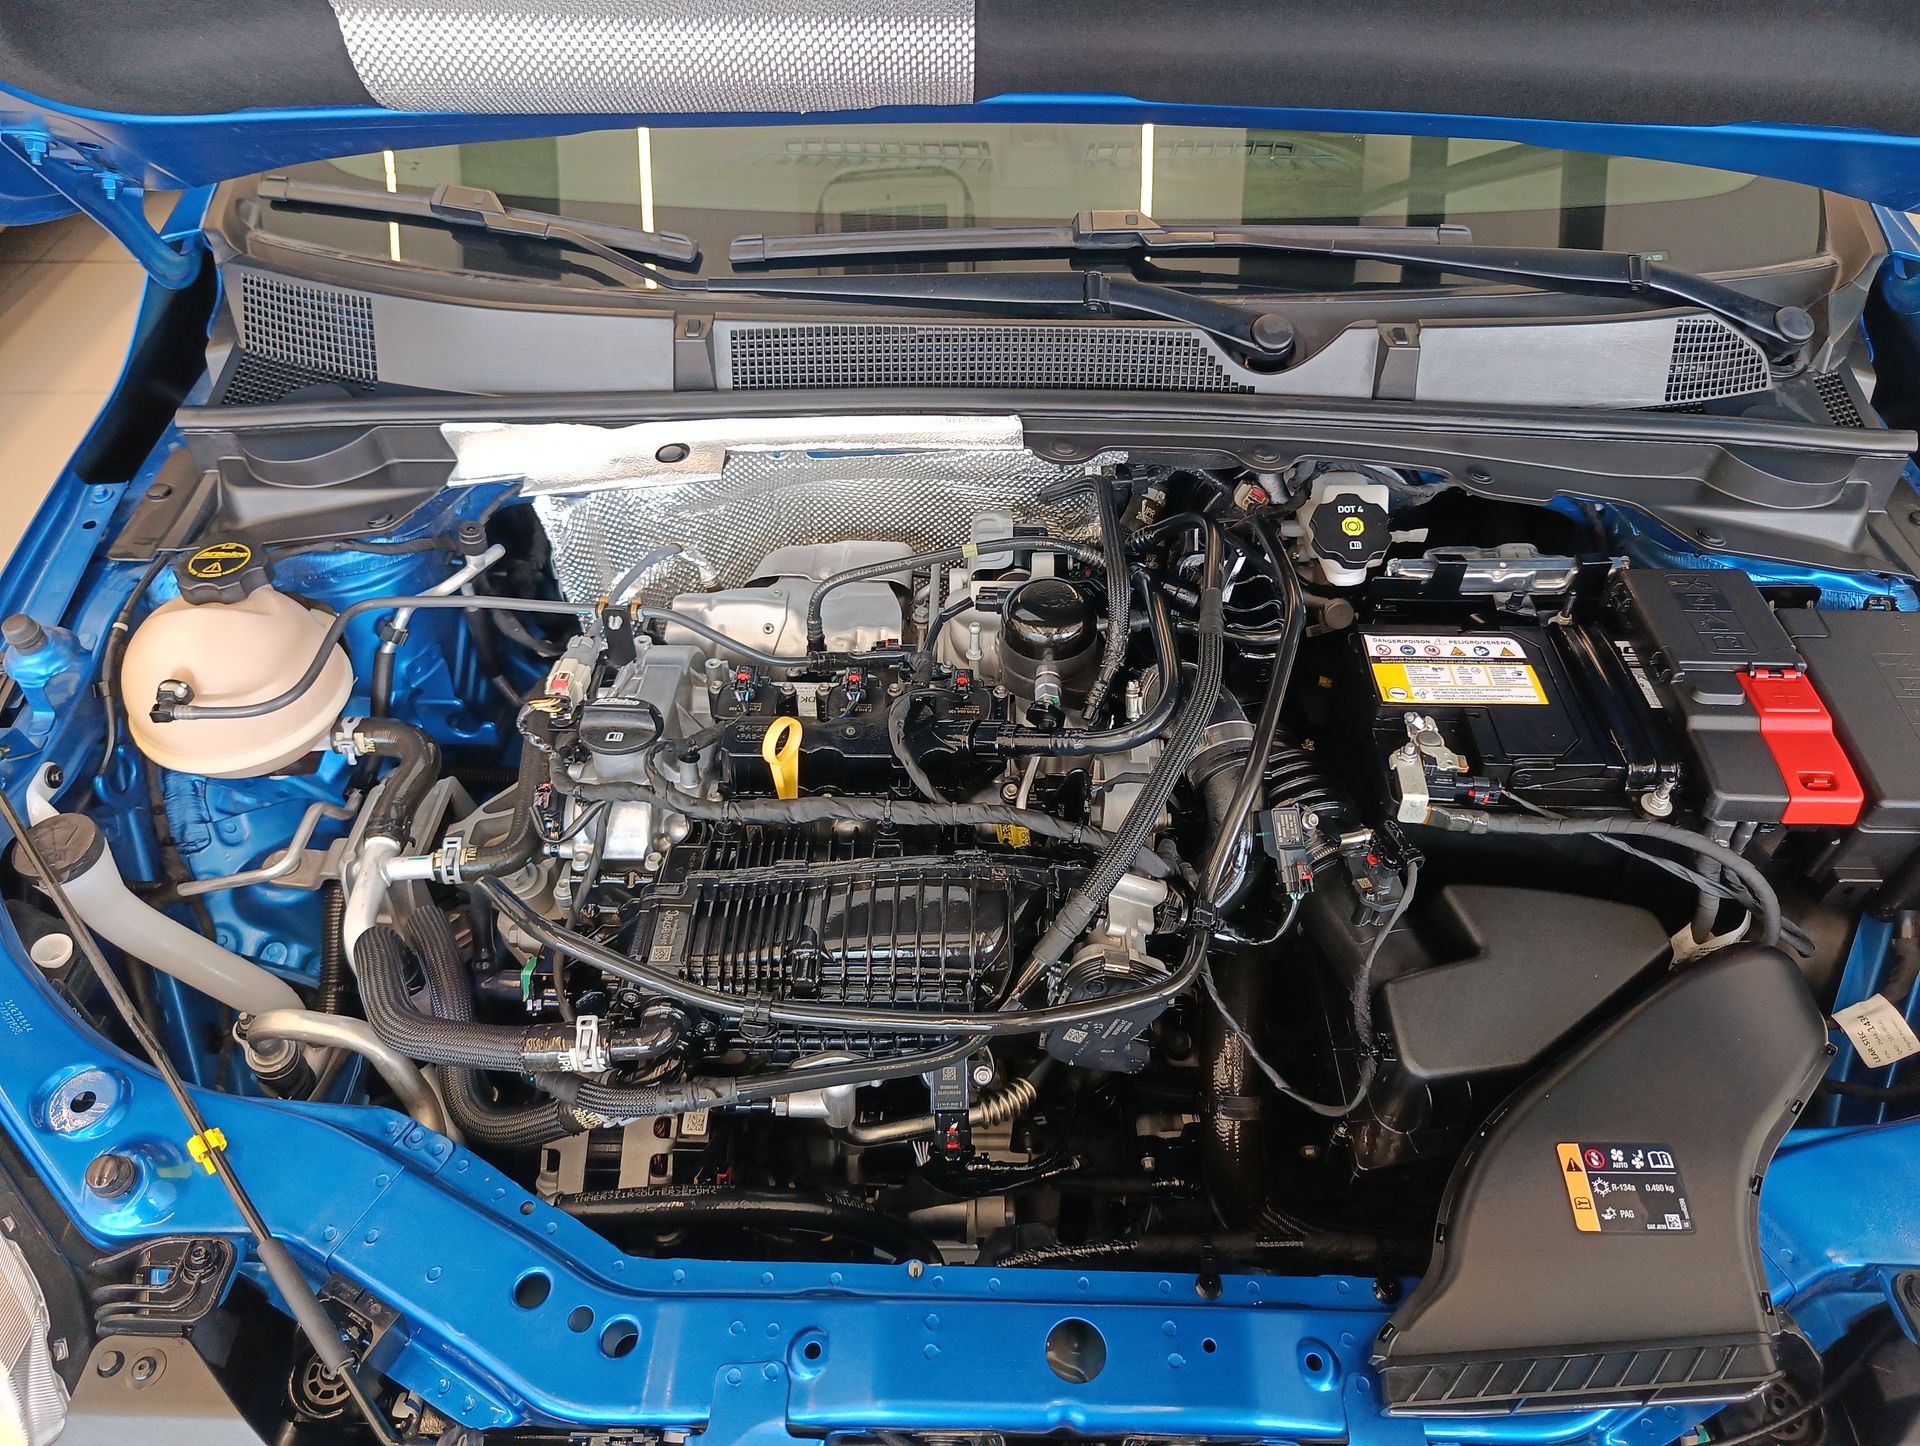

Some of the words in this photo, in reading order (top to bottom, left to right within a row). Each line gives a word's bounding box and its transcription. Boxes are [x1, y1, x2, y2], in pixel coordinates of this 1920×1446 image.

[1856, 1030, 1881, 1063] LEAR-STEC
[558, 1053, 573, 1072] UPR
[1612, 1184, 1636, 1192] R-134a
[1665, 1184, 1674, 1193] kg
[1620, 1210, 1635, 1219] PAG
